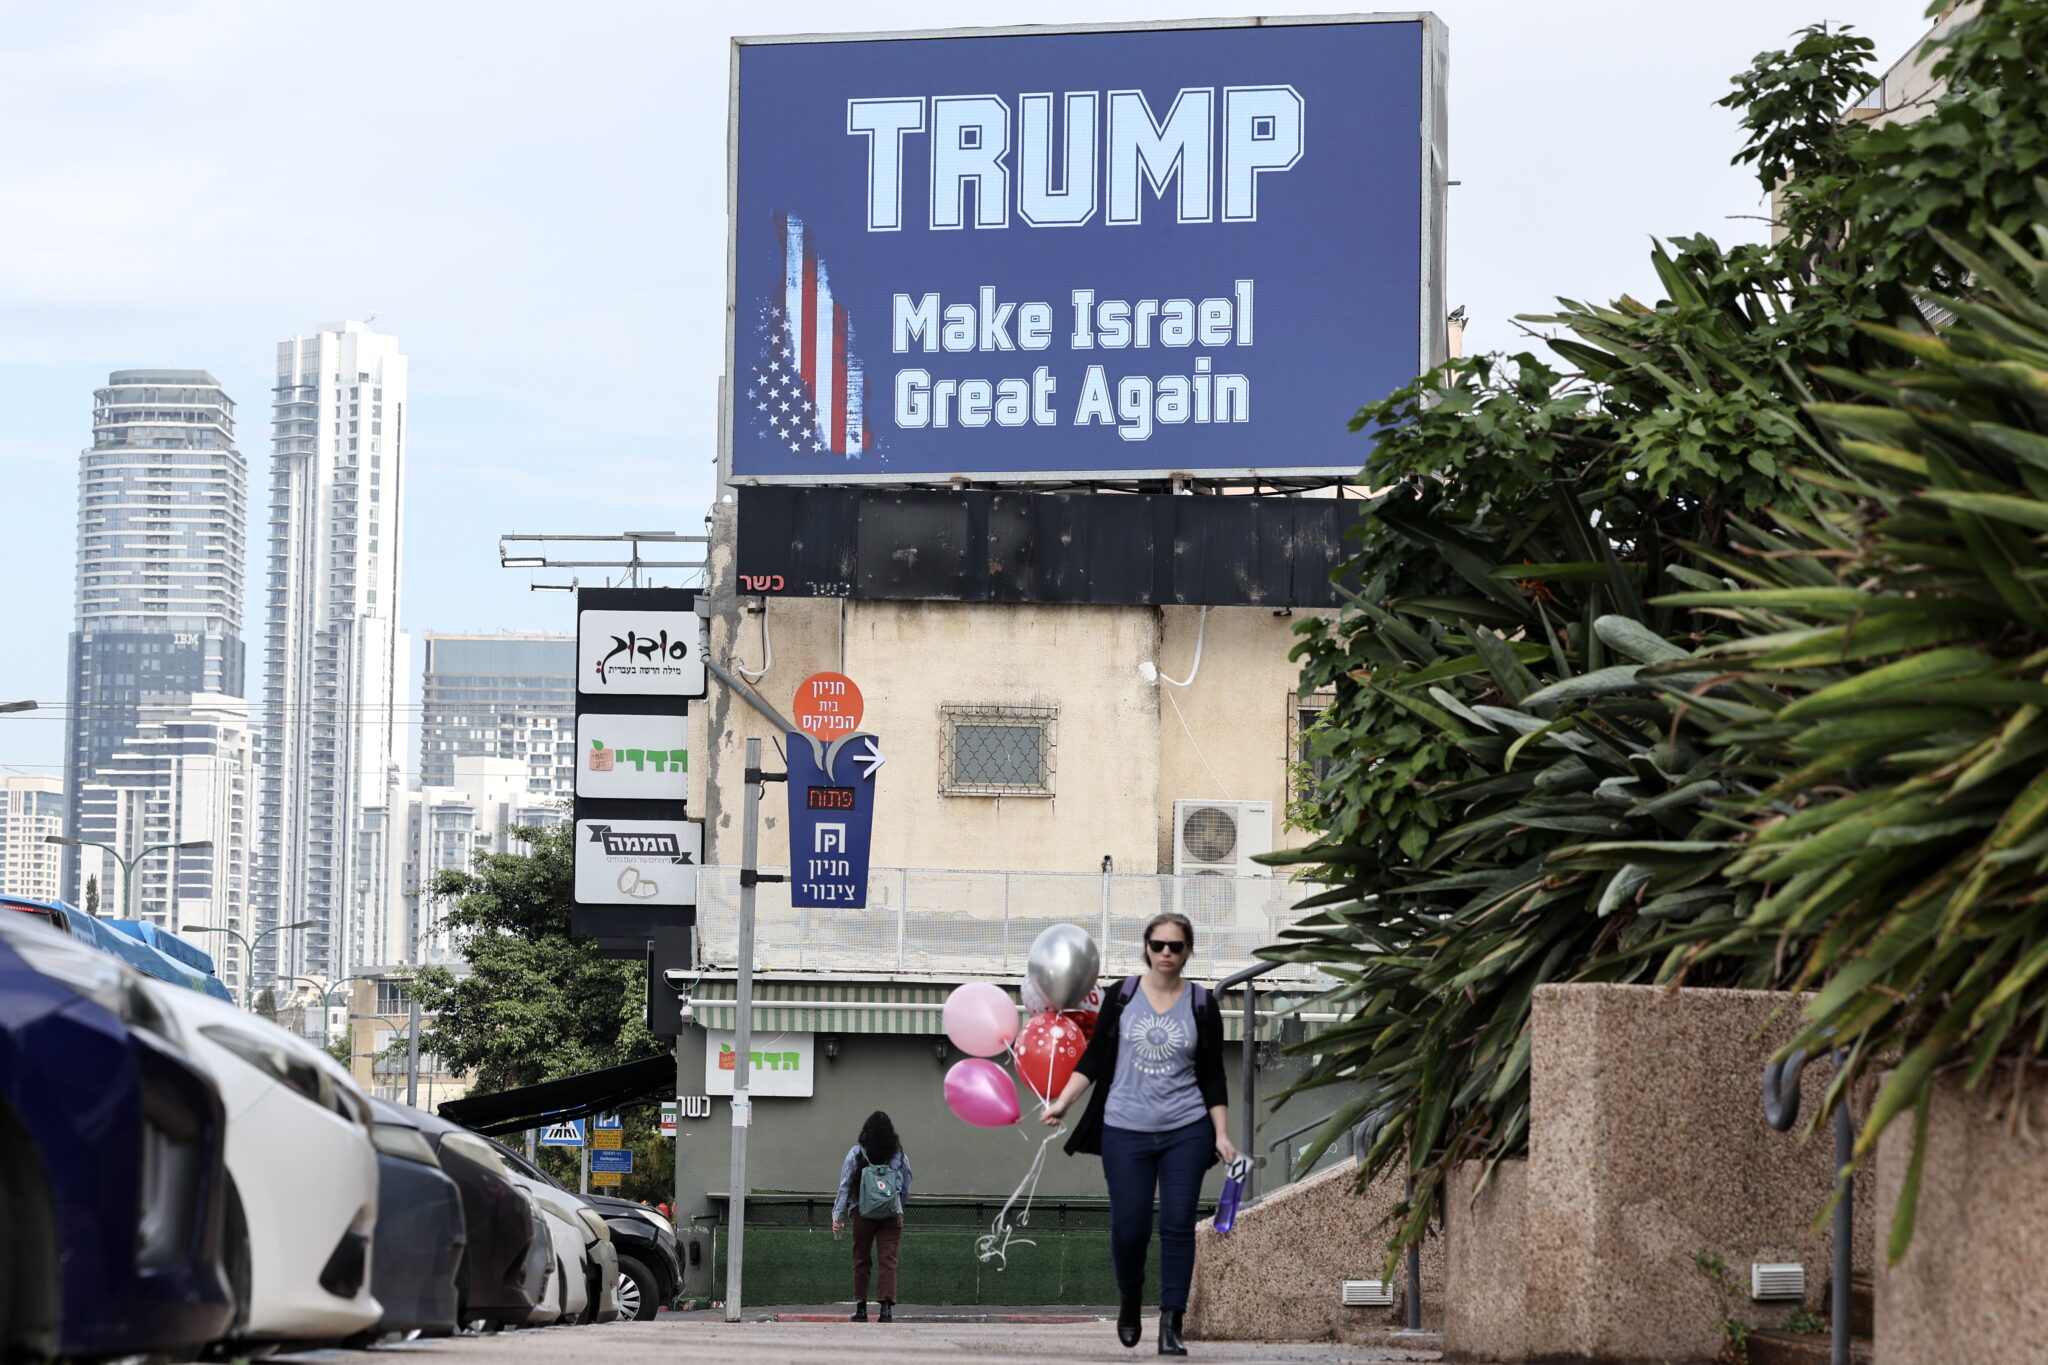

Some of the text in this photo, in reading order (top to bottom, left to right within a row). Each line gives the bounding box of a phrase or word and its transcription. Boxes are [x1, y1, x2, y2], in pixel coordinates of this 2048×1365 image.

[847, 84, 1304, 232] TRUMP
[892, 279, 1254, 353] Make Israel
[894, 356, 1250, 441] Great Again
[739, 574, 785, 591] כשר
[173, 633, 200, 645] IBM
[608, 665, 682, 675] מילה חדשה בעברית
[812, 681, 845, 699] חניון
[818, 700, 839, 712] בית
[802, 715, 855, 732] הפניקס
[809, 789, 853, 808] פתוח
[608, 836, 674, 852] חממה
[808, 859, 850, 880] חניון
[802, 884, 855, 901] ציבורי
[749, 1051, 800, 1071] הדר
[676, 1095, 711, 1118] כשר
